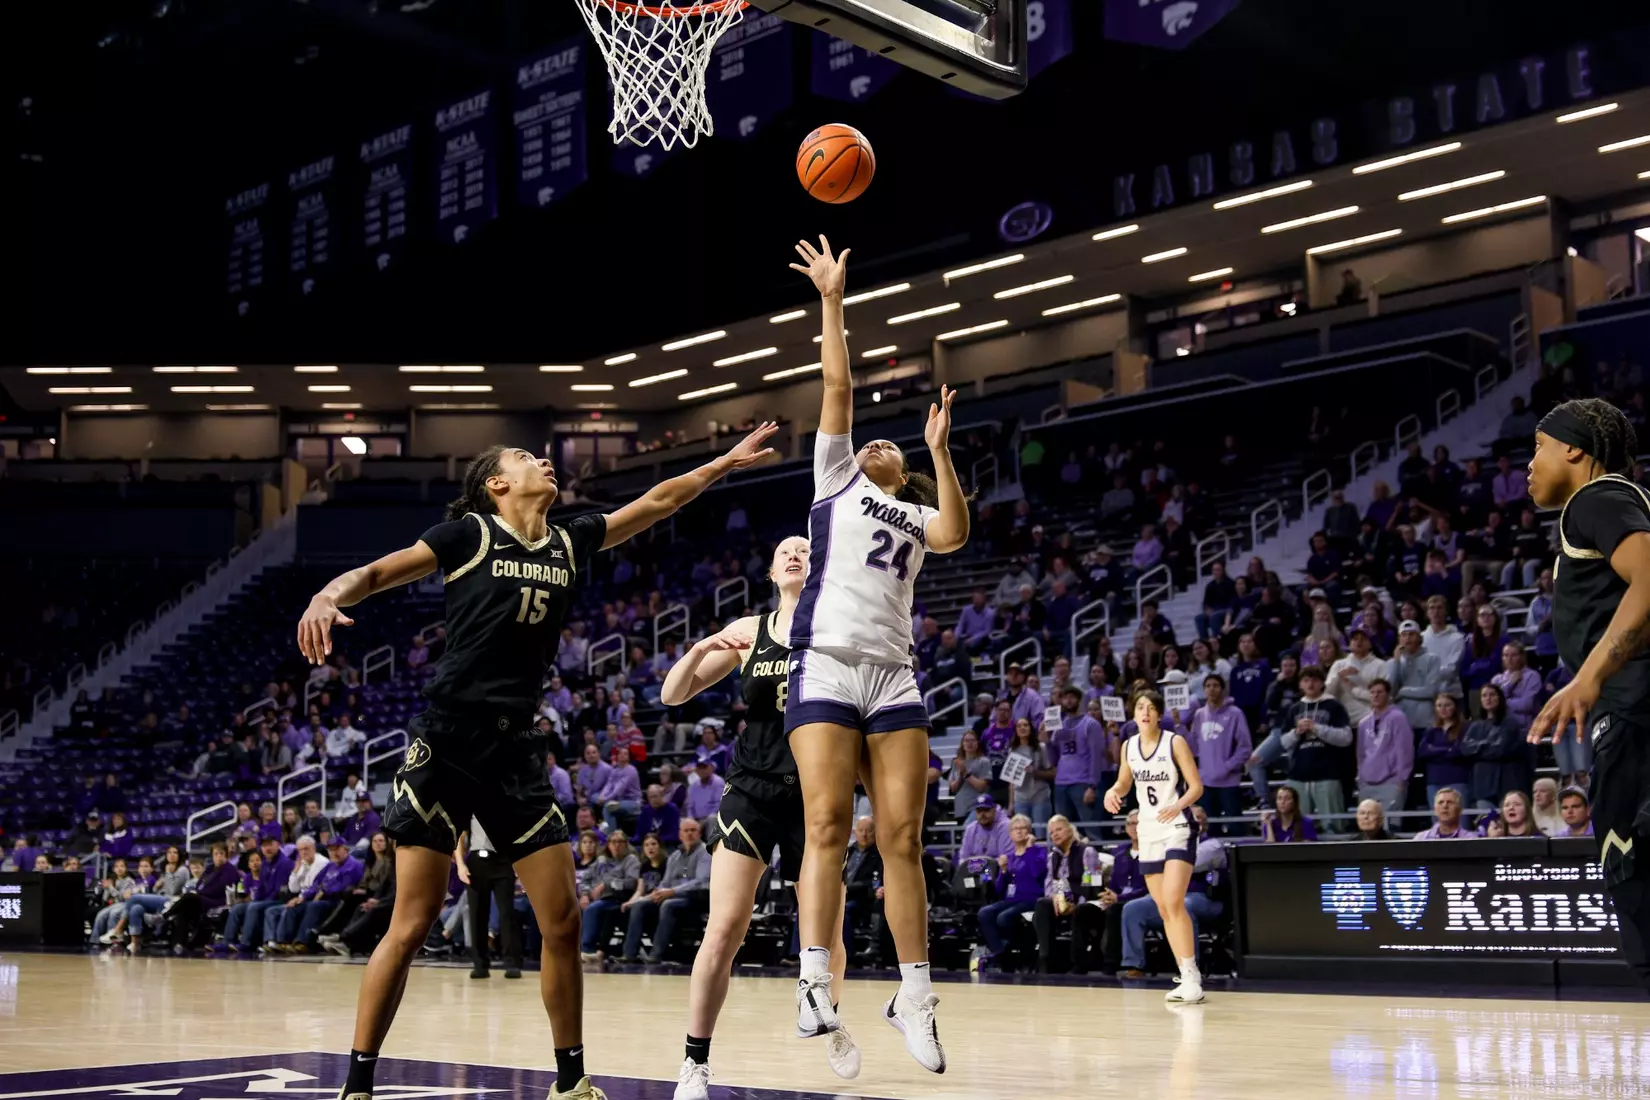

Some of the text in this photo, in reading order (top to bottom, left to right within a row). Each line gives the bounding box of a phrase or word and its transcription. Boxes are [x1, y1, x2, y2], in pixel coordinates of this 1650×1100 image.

[1112, 47, 1593, 216] KANSAS STATE
[492, 559, 569, 587] COLORADO
[865, 529, 914, 581] 24
[516, 586, 550, 624] 15
[1133, 769, 1169, 782] Wildcats
[1147, 786, 1158, 806] 6
[1442, 881, 1619, 932] Kans
